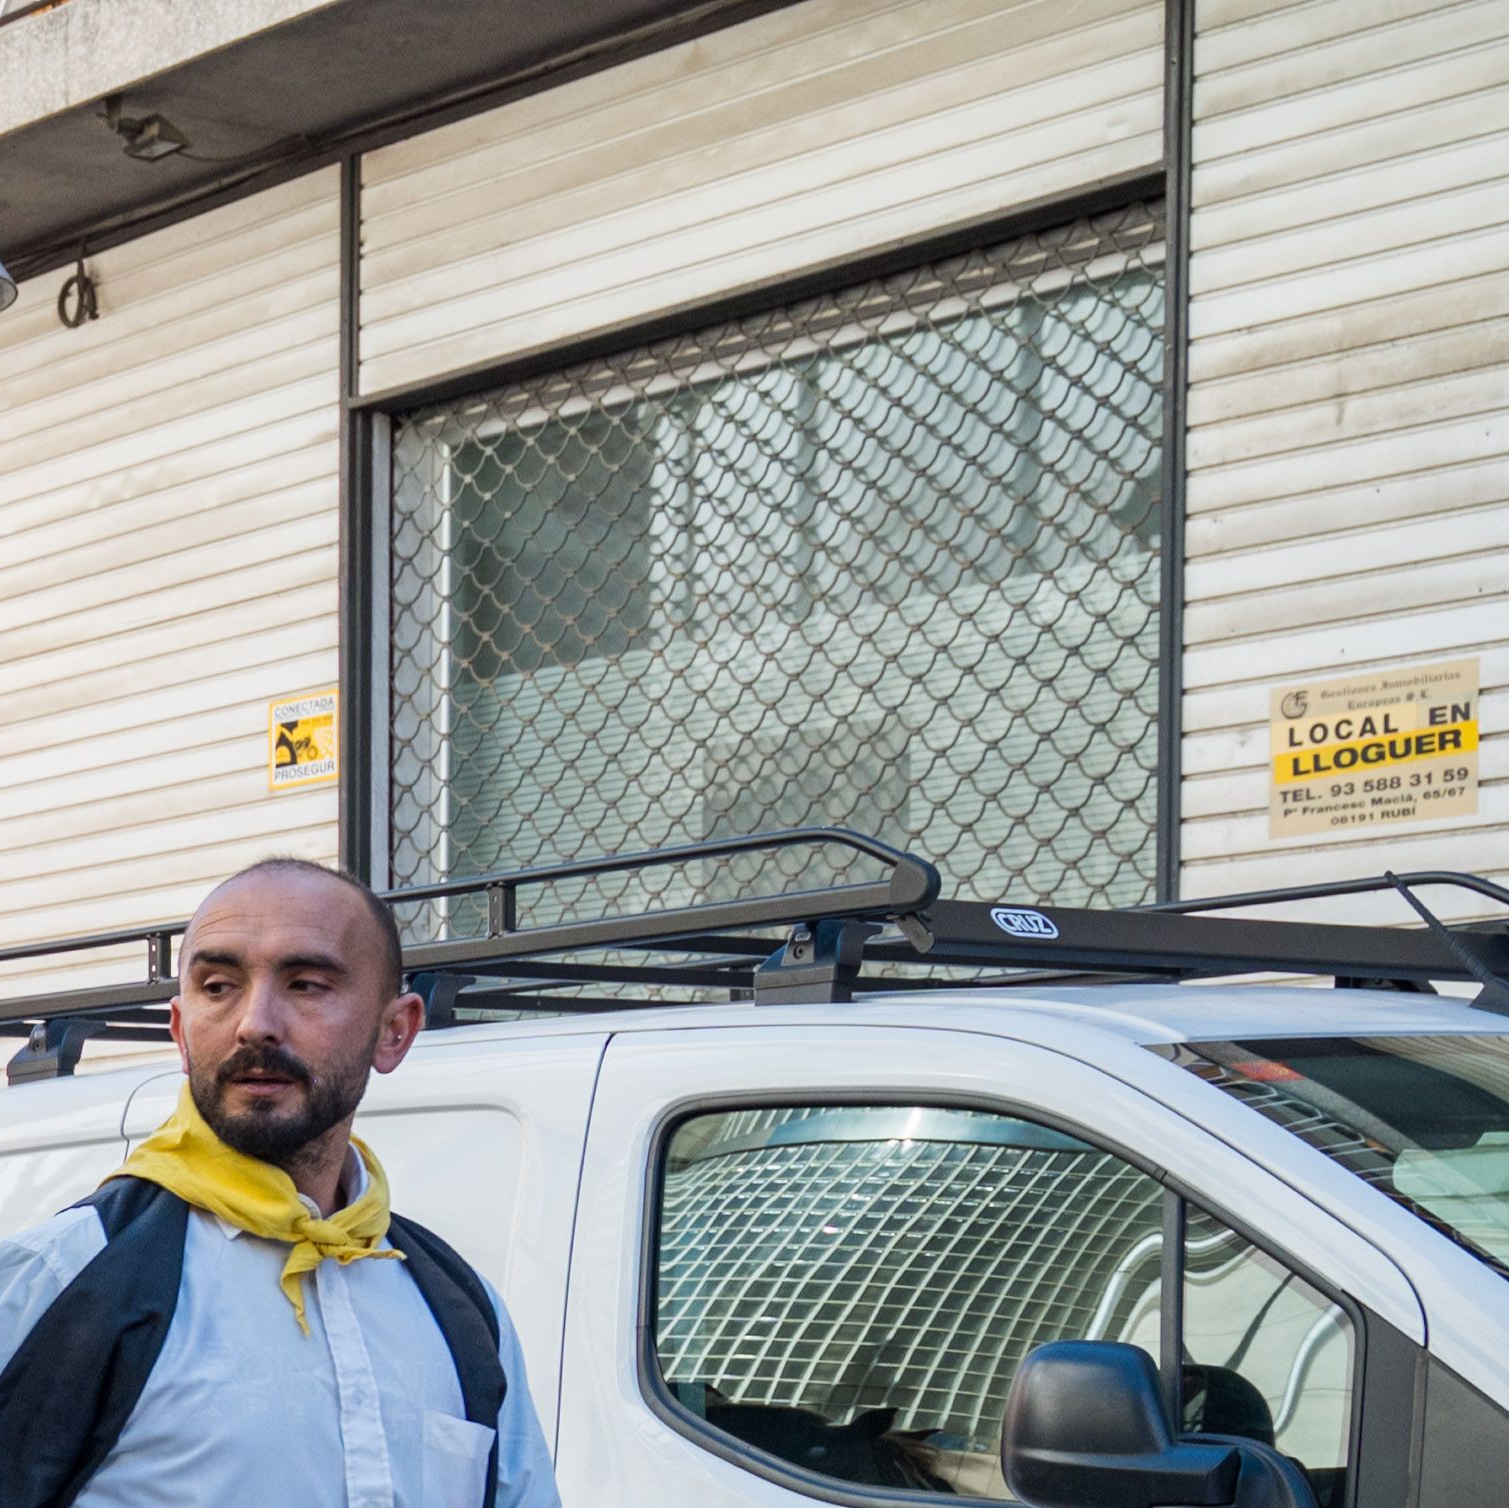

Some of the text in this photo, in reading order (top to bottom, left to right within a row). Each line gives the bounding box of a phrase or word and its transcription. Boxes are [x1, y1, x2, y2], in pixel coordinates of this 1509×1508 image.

[274, 697, 334, 718] CONECTADA
[1288, 702, 1471, 748] LOCAL EN
[1292, 729, 1462, 776] LLOGUER
[274, 760, 335, 781] PROSEGUR
[1280, 766, 1469, 804] TEL. 93 588 31 59
[1302, 801, 1365, 816] Francesc
[997, 912, 1053, 934] CRUZ
